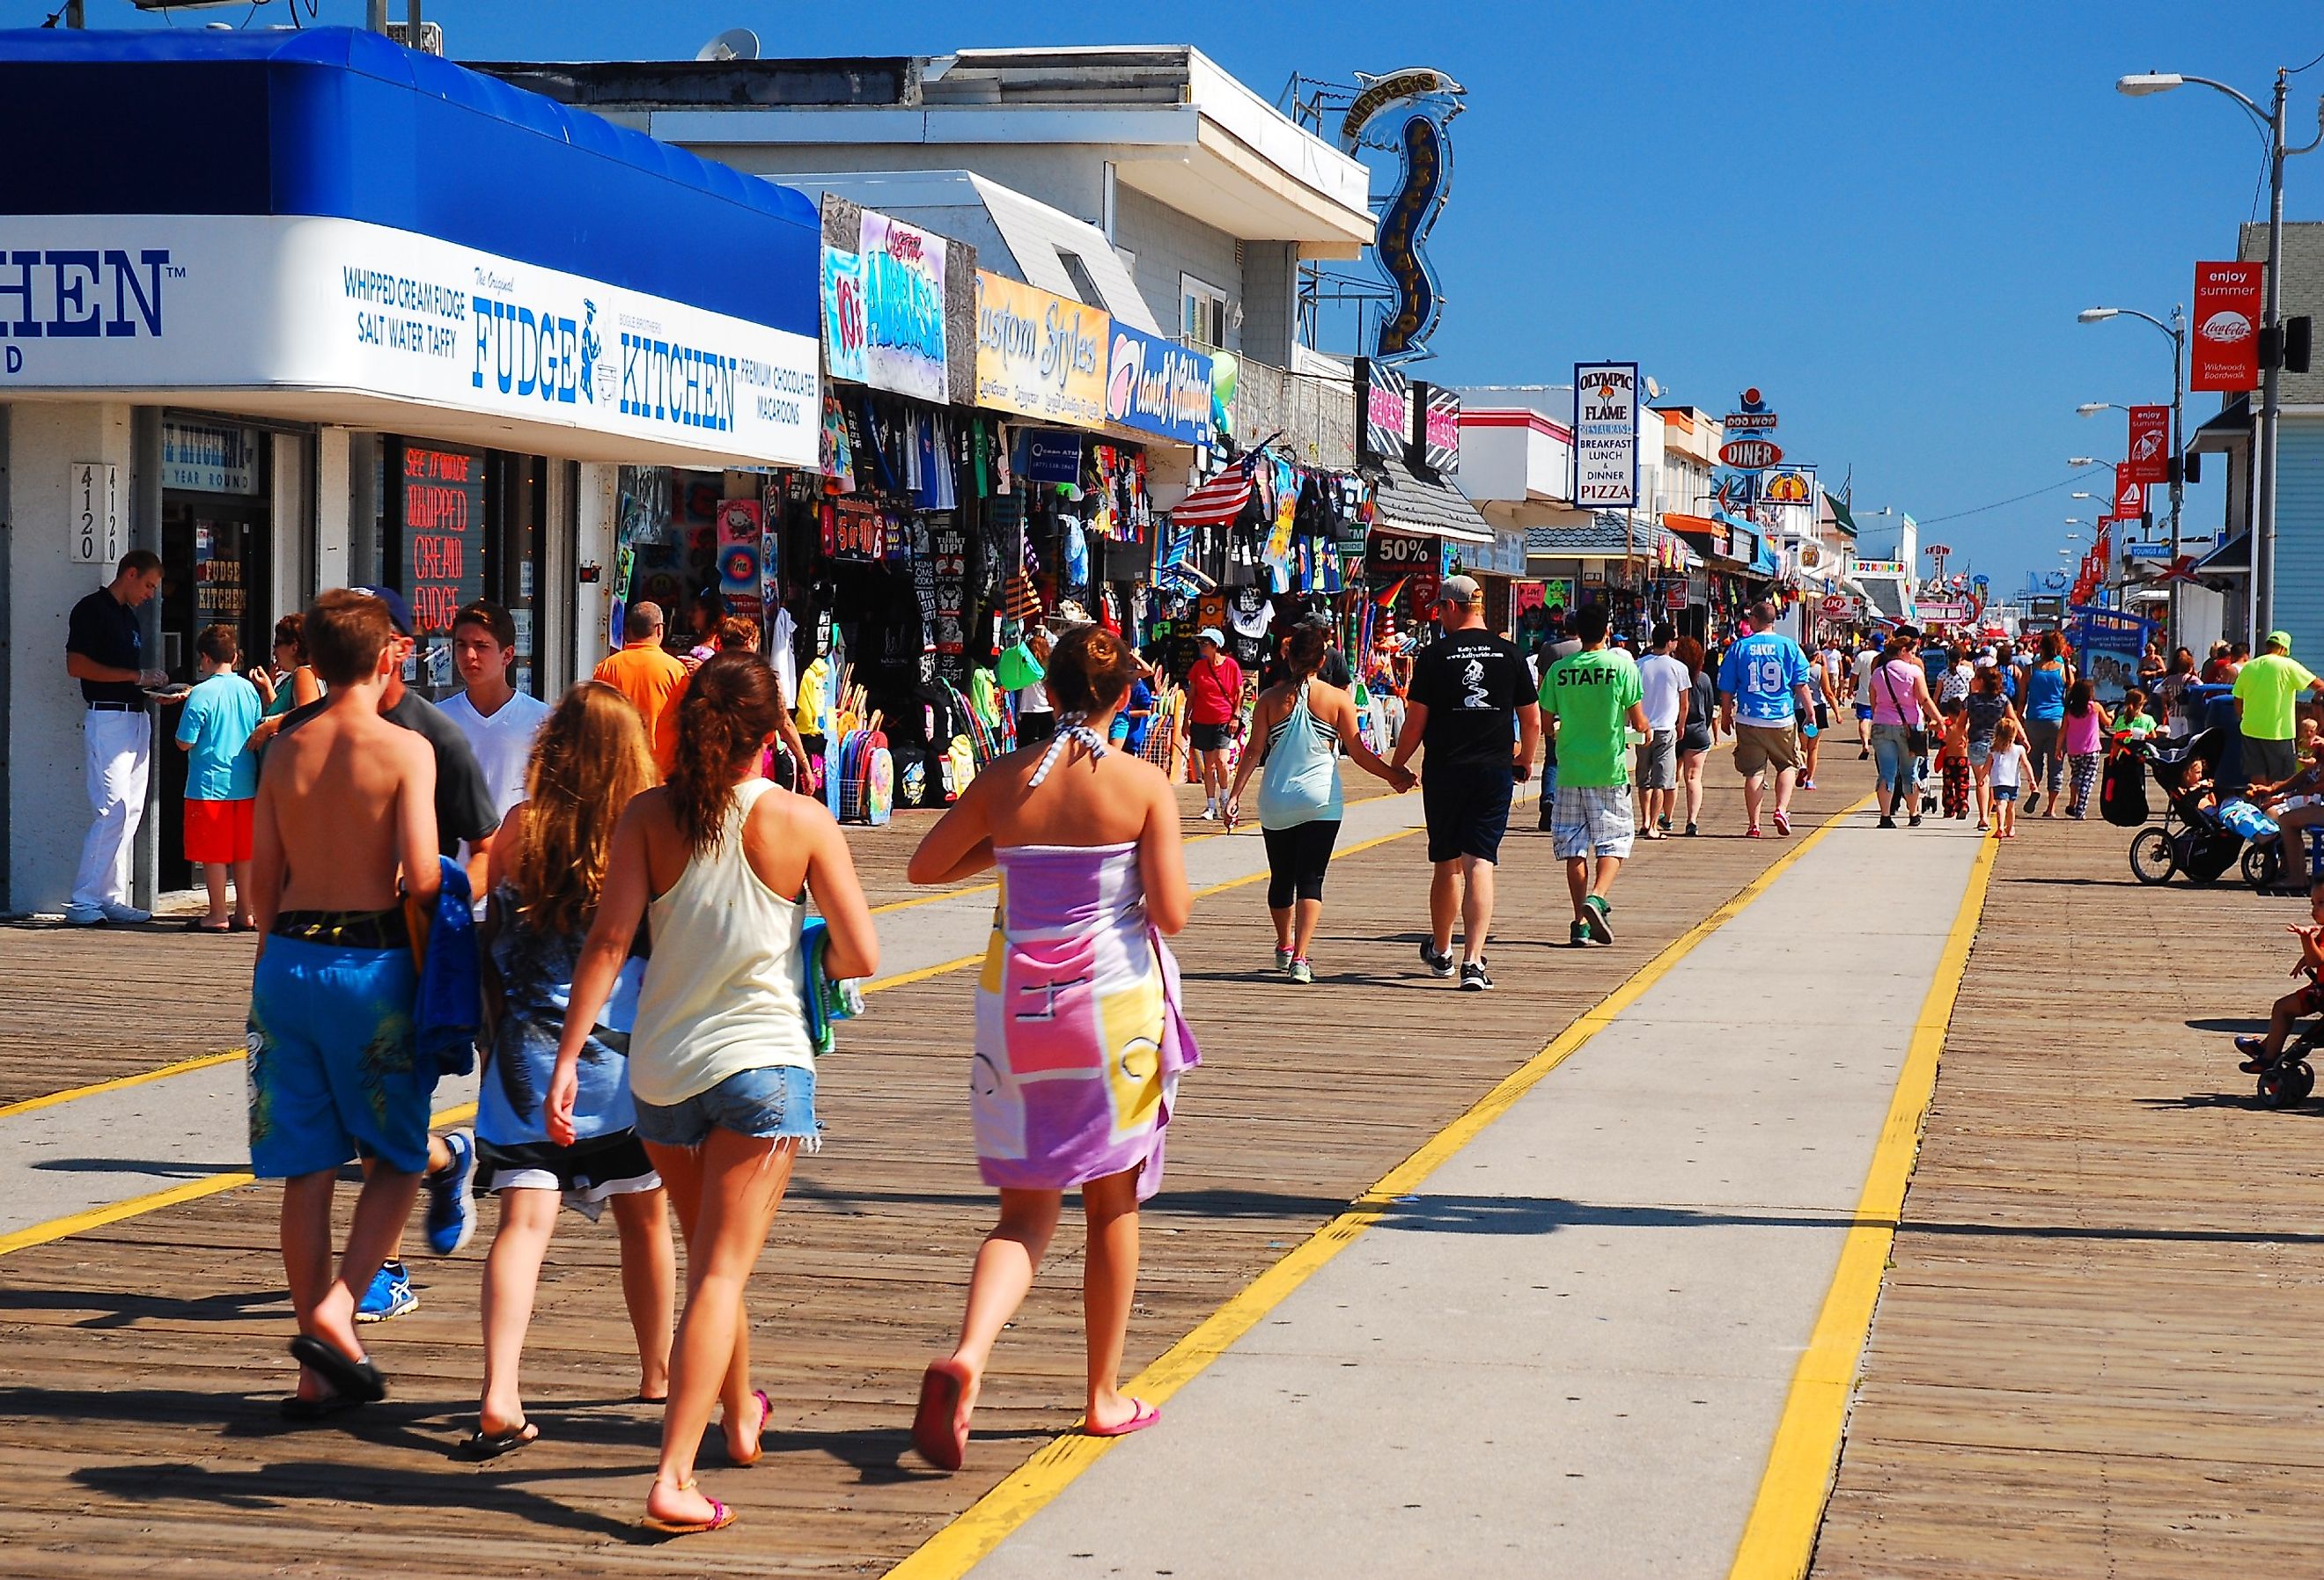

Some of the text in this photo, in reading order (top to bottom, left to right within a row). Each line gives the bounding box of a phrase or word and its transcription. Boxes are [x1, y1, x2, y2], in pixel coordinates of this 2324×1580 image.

[474, 267, 514, 296] The Original
[2210, 270, 2247, 283] enjoy
[343, 266, 465, 321] WHIPPED CREAM FUDGE
[2201, 286, 2255, 296] summer
[357, 312, 456, 359] SALT WATER TAFFY
[473, 296, 576, 403] FUDGE
[1041, 302, 1097, 392] Styles
[620, 333, 737, 433] KITCHEN
[741, 358, 814, 397] PREMIUM CHOCOLATES
[1580, 371, 1633, 391] OLYMPIC
[757, 396, 799, 425] MACAROONS
[1585, 406, 1627, 421] FLAME
[1727, 416, 1775, 426] DOO WOP
[1032, 444, 1061, 457] Ocean
[1580, 439, 1631, 448] BREAKFAST
[1728, 443, 1772, 466] DINER
[405, 448, 425, 477] SEE
[174, 470, 247, 488] YEAR ROUND
[1587, 471, 1624, 480] DINNER
[1581, 485, 1630, 499] PIZZA
[408, 485, 468, 532] WHIPPED
[414, 535, 463, 579] CREAM
[939, 544, 963, 554] UP!
[1379, 539, 1428, 562] 50%
[2133, 547, 2157, 555] YOUNGS
[205, 560, 240, 582] FUDGE
[198, 587, 246, 609] KITCHEN
[414, 585, 460, 631] FUDGE
[1749, 644, 1776, 656] SAKIC
[1557, 668, 1616, 687] STAFF
[1747, 662, 1782, 693] 19
